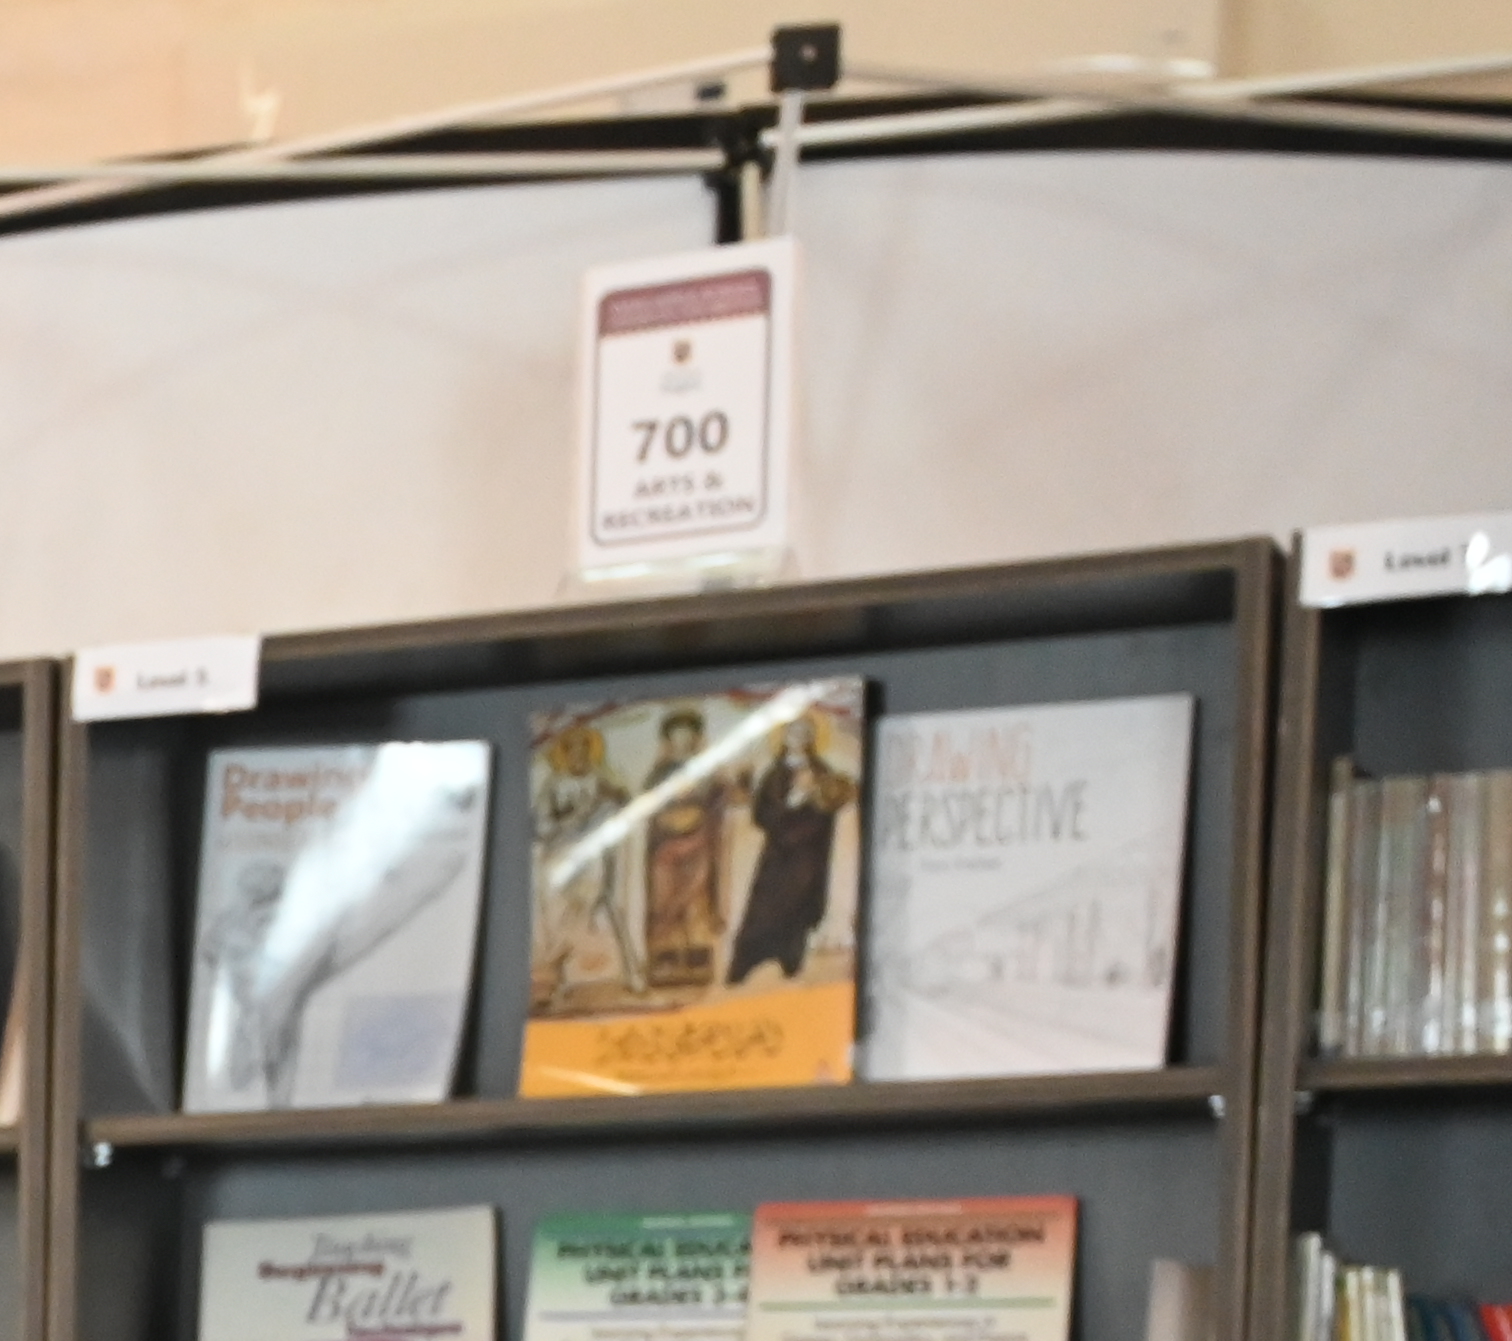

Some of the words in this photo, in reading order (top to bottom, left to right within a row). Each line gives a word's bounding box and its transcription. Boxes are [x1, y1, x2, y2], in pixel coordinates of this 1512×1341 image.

[632, 407, 731, 465] 700
[636, 472, 695, 498] ARTS
[602, 496, 755, 531] RECREATION
[305, 1269, 454, 1325] Ballet
